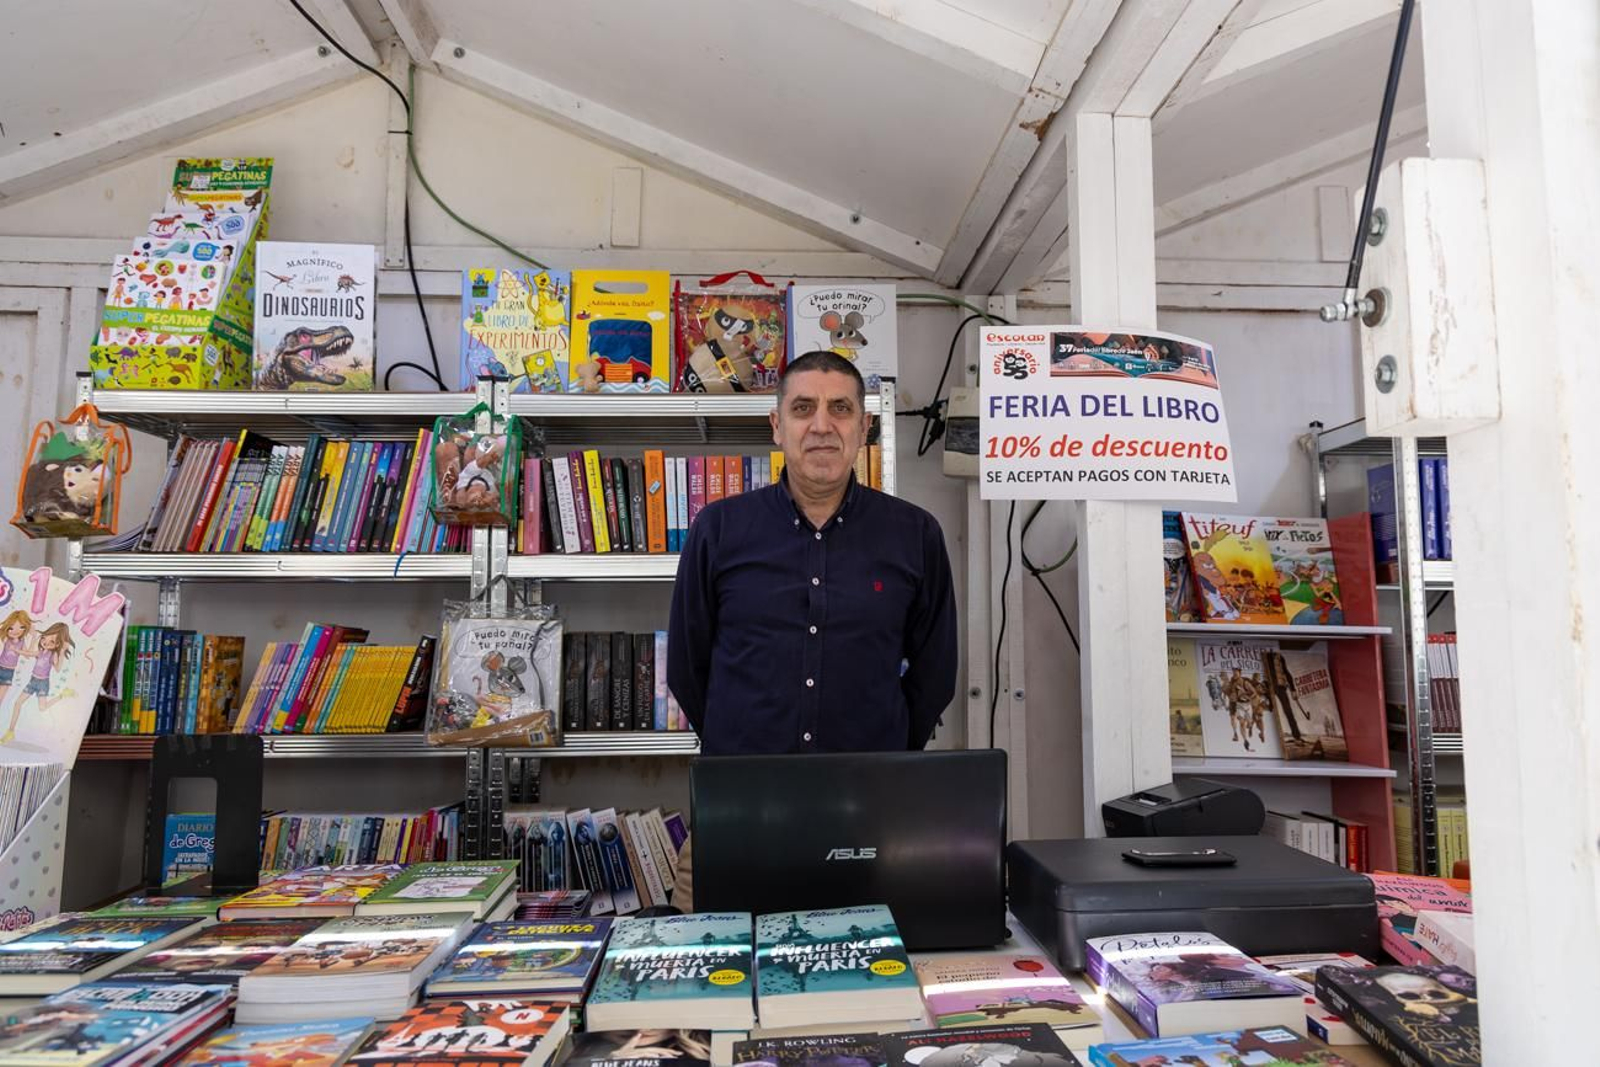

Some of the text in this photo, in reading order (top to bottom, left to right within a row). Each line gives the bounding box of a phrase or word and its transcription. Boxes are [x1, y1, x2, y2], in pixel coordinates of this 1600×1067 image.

[211, 171, 267, 181] PEGATINAS
[810, 291, 874, 306] ¿Puedo mirar
[263, 293, 364, 320] DINOSAURIOS
[817, 301, 867, 312] tu orinal?
[104, 311, 211, 326] SUPER PEGATINAS
[469, 329, 567, 350] EXPERIMENTOS
[986, 333, 1045, 342] escolar
[1060, 343, 1074, 353] 37
[994, 348, 1037, 375] aniversario
[989, 394, 1220, 424] FERIA DEL LIBRO
[985, 434, 1228, 461] 10% de descuento
[986, 469, 1231, 485] SE ACEPTAN PAGOS CON TARJETA
[1188, 515, 1257, 540] titeuf
[29, 566, 125, 637] 1 M
[478, 640, 491, 650] tu
[1201, 646, 1215, 667] LA
[1220, 659, 1236, 670] DEL
[1294, 668, 1327, 686] CARRETERA
[178, 823, 214, 832] DIARIO
[170, 834, 184, 848] de
[826, 848, 876, 860] ASUS
[1376, 884, 1447, 896] uímica
[769, 937, 895, 956] INFLUENCER
[615, 948, 742, 963] INFLUENCER
[784, 1037, 857, 1047] ROWLING
